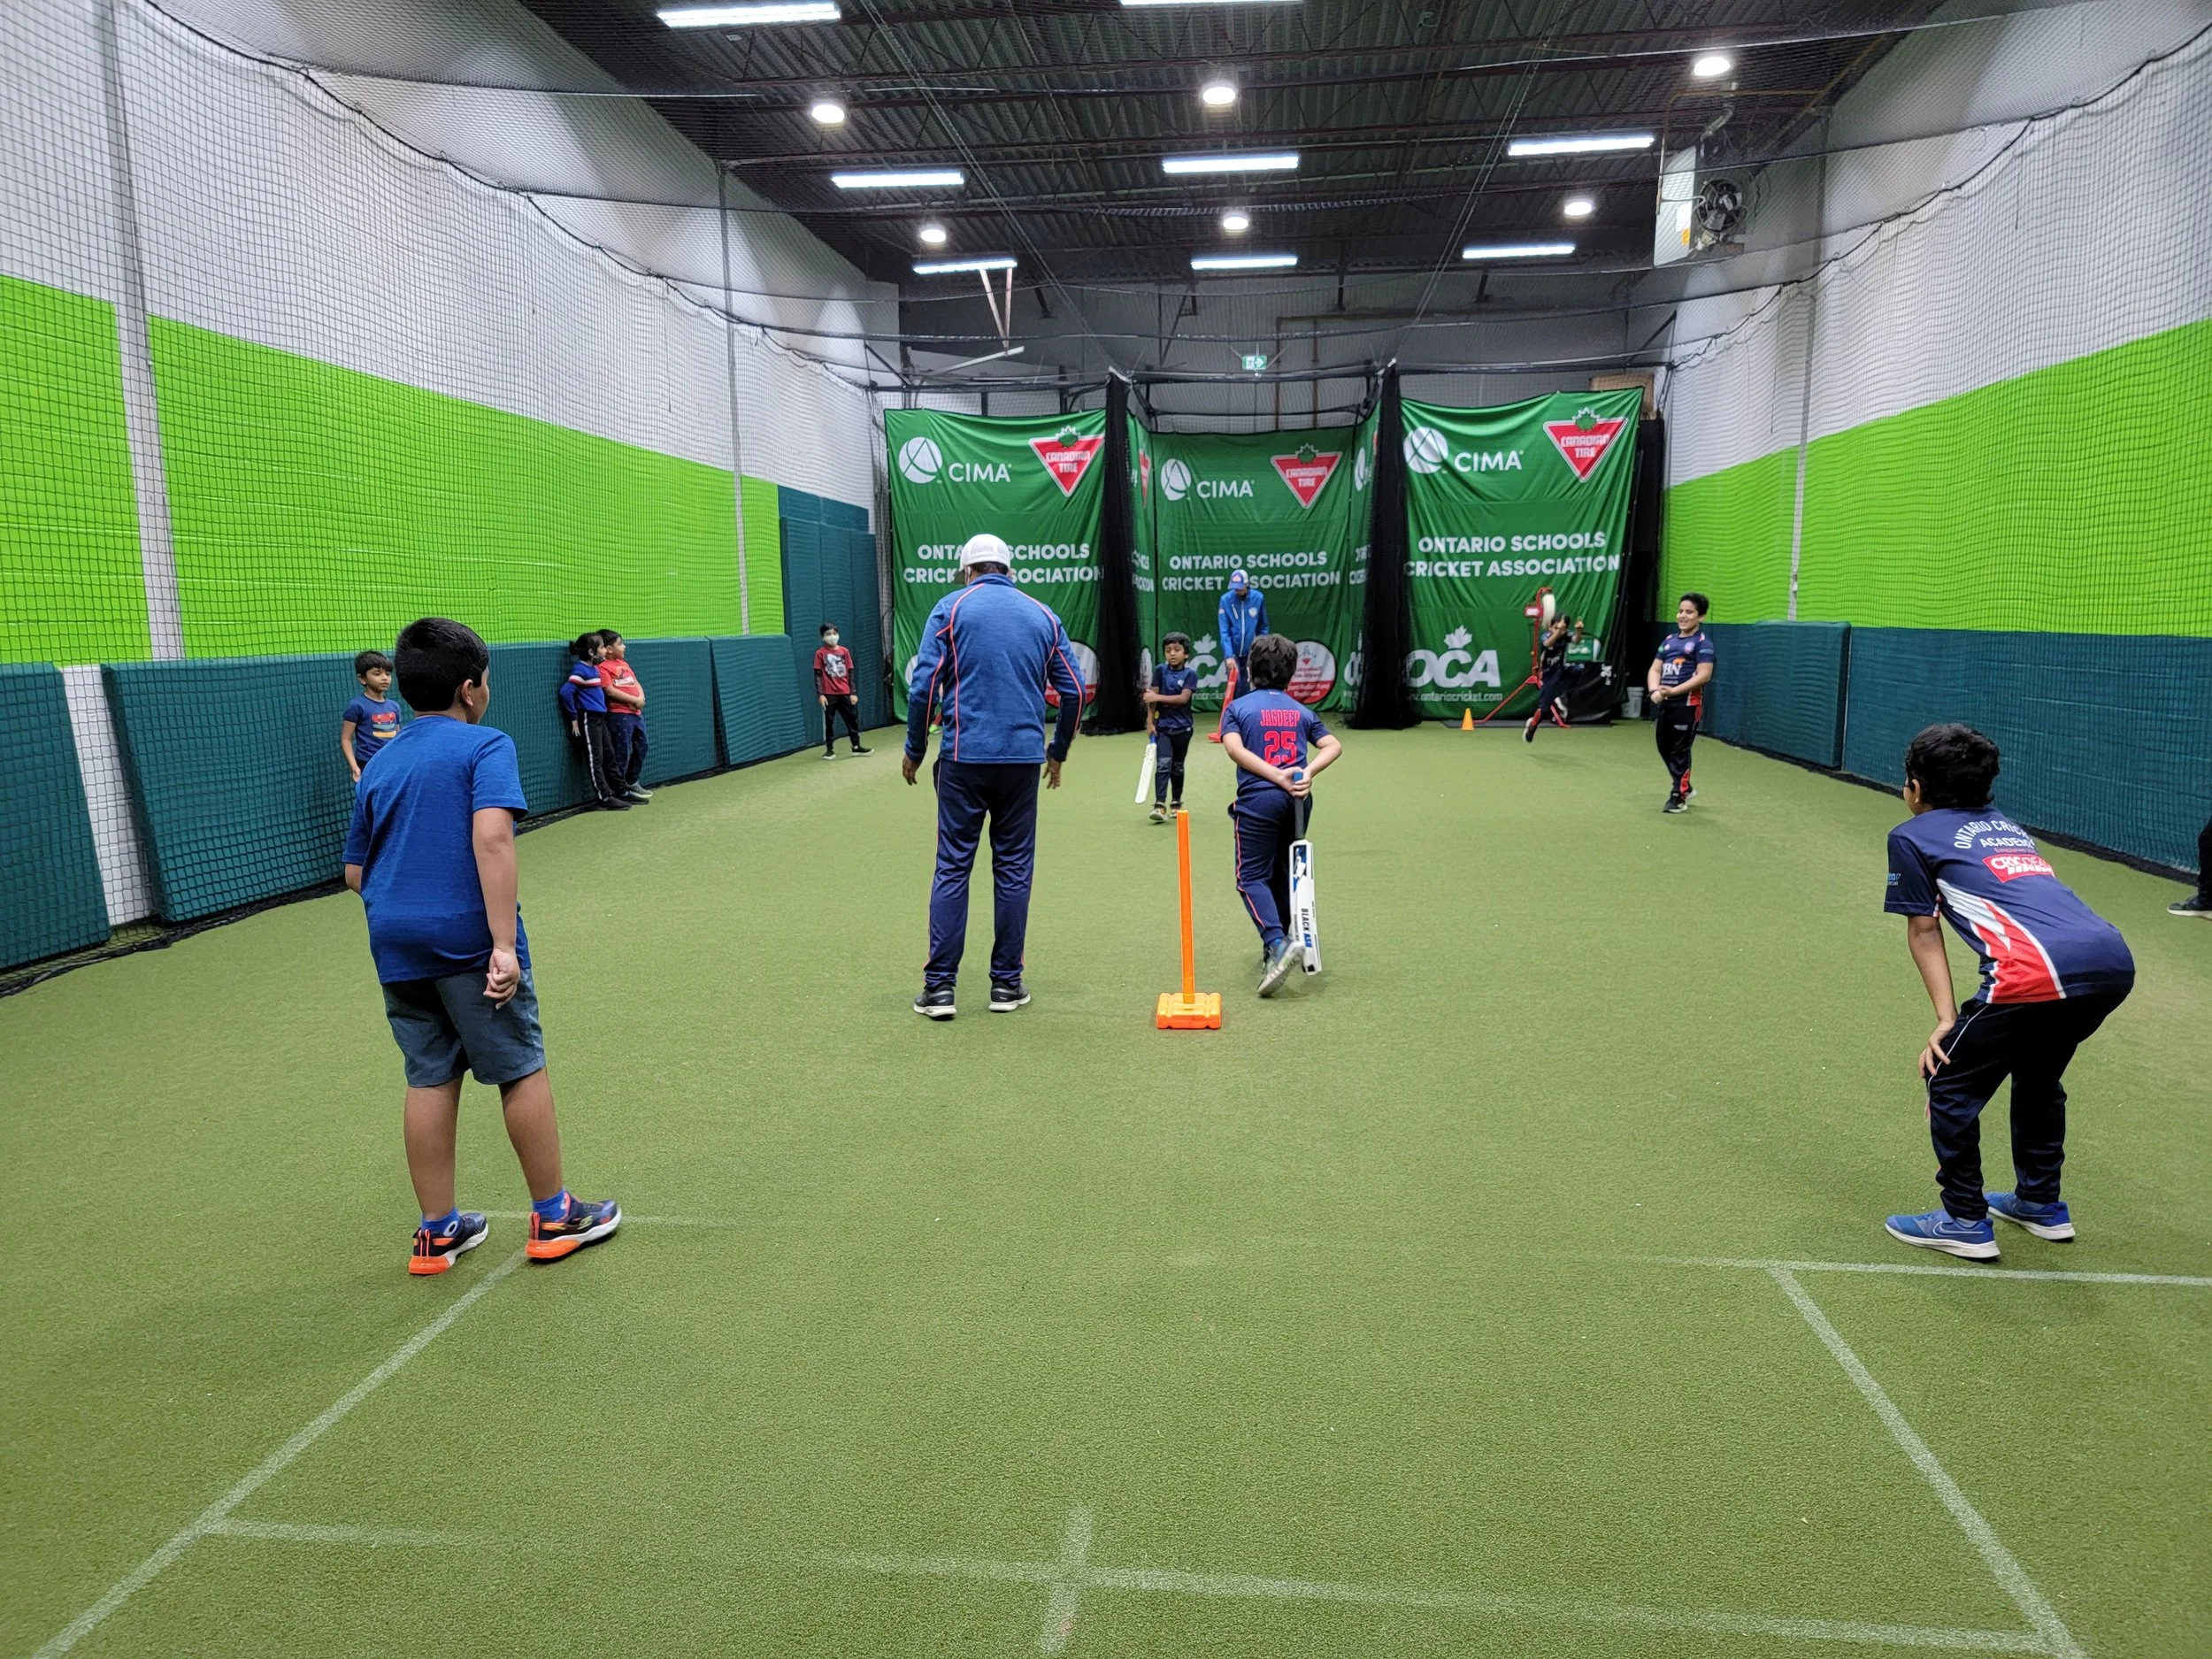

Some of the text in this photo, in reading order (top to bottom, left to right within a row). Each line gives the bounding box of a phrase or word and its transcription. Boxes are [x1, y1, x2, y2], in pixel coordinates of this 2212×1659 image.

[1454, 450, 1523, 472] CIMA
[948, 463, 1011, 482] CIMA
[1196, 480, 1254, 499] CIMA
[918, 544, 963, 560] ONTA
[1418, 531, 1606, 553] ONTARIO SCHOOLS
[1169, 555, 1242, 571] ONTARIO
[1247, 551, 1327, 568] SCHOOLS
[1402, 554, 1621, 577] CRICKET ASSOCIATION
[1162, 576, 1224, 592] CRICKET
[1249, 571, 1340, 589] SOCIATION
[1406, 649, 1502, 688] OCA
[1259, 709, 1301, 727] JAGDEEP
[1263, 730, 1298, 766] 25
[1954, 820, 2030, 849] ONTARIO CRICK
[1301, 908, 1310, 932] BLACK
